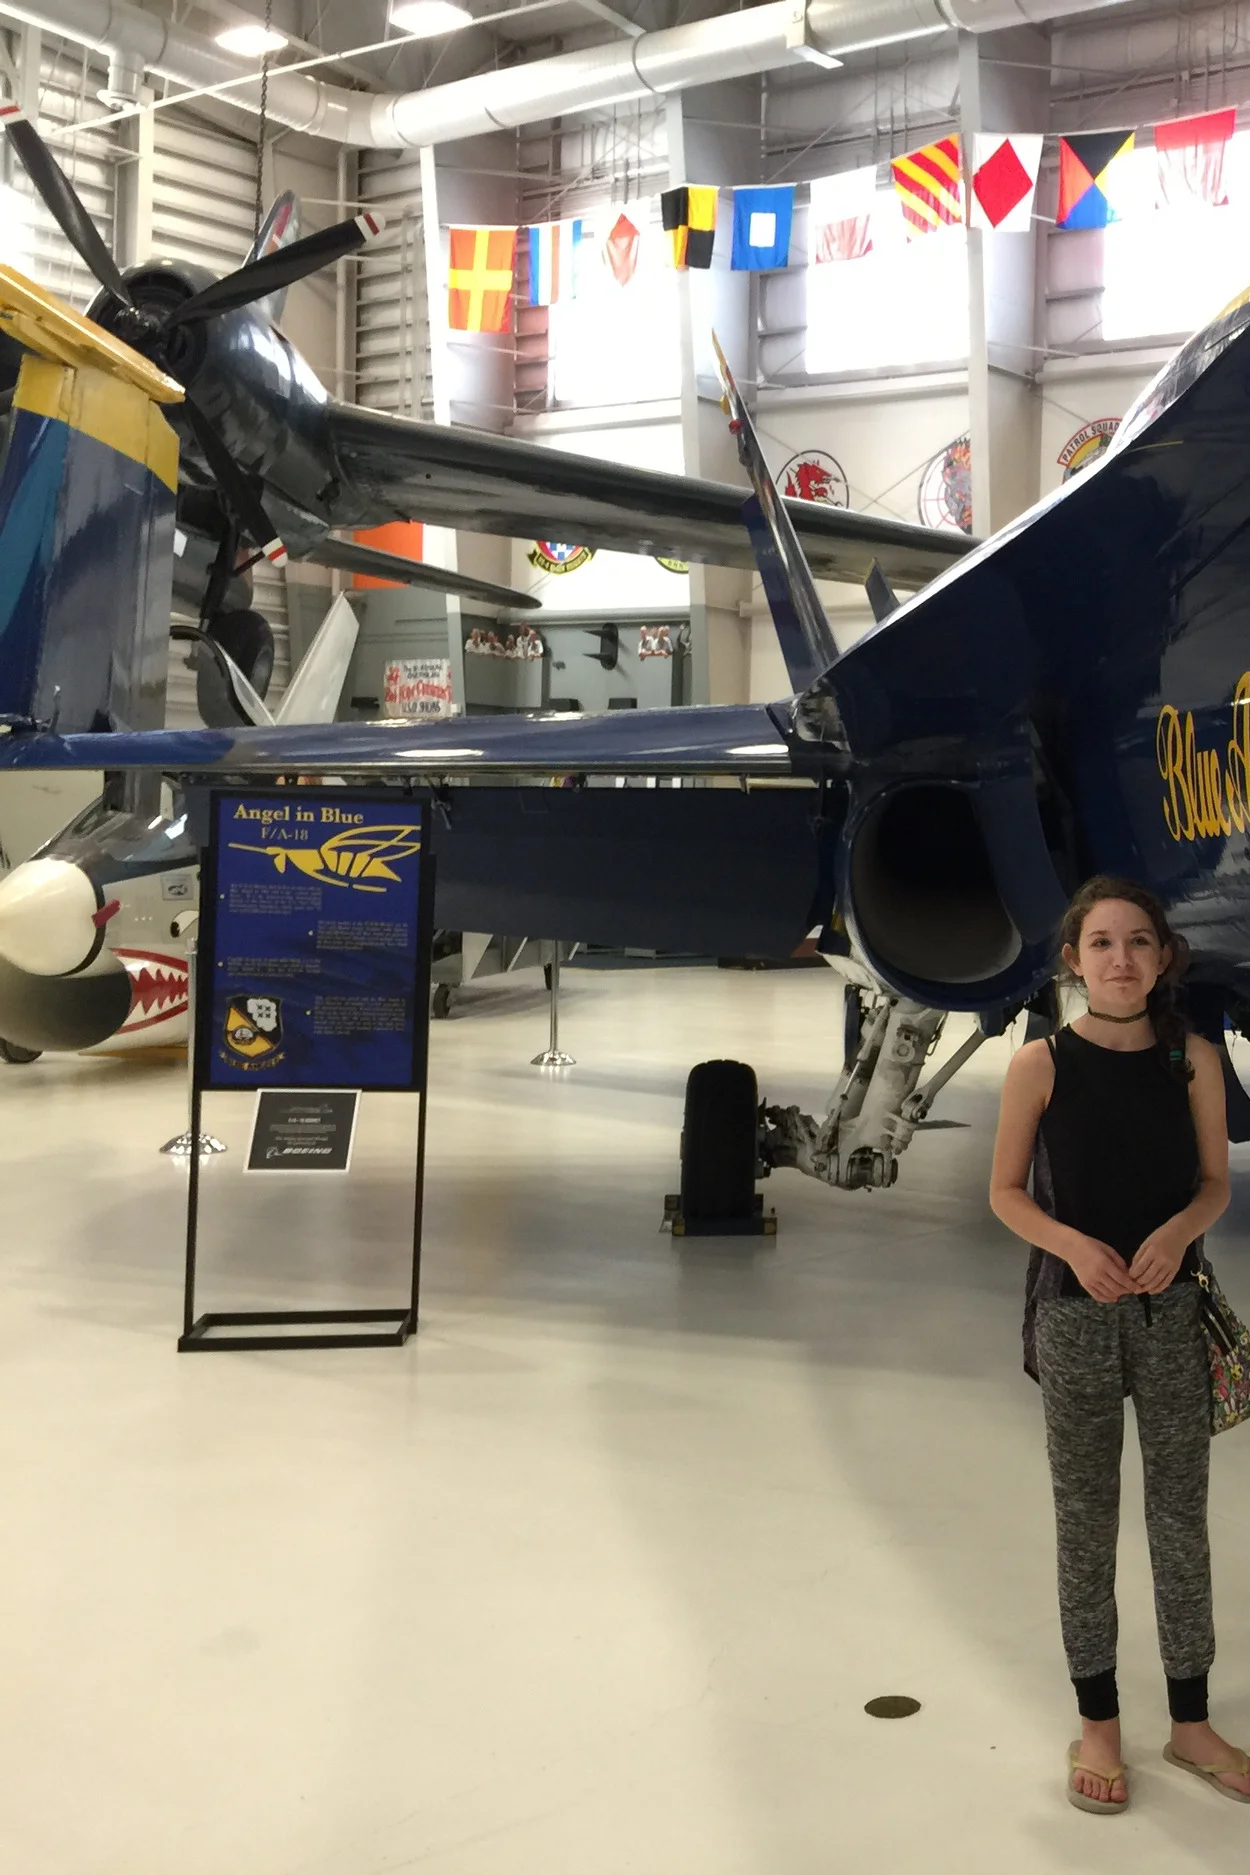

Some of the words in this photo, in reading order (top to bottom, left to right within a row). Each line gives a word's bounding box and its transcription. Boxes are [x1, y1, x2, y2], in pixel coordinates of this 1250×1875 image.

[1062, 431, 1090, 462] PATROL
[1156, 704, 1231, 841] Blue
[233, 804, 290, 825] Angel
[295, 806, 315, 822] in
[320, 807, 364, 824] Blue
[261, 827, 308, 840] F/A-18
[282, 1147, 333, 1155] BOEING
